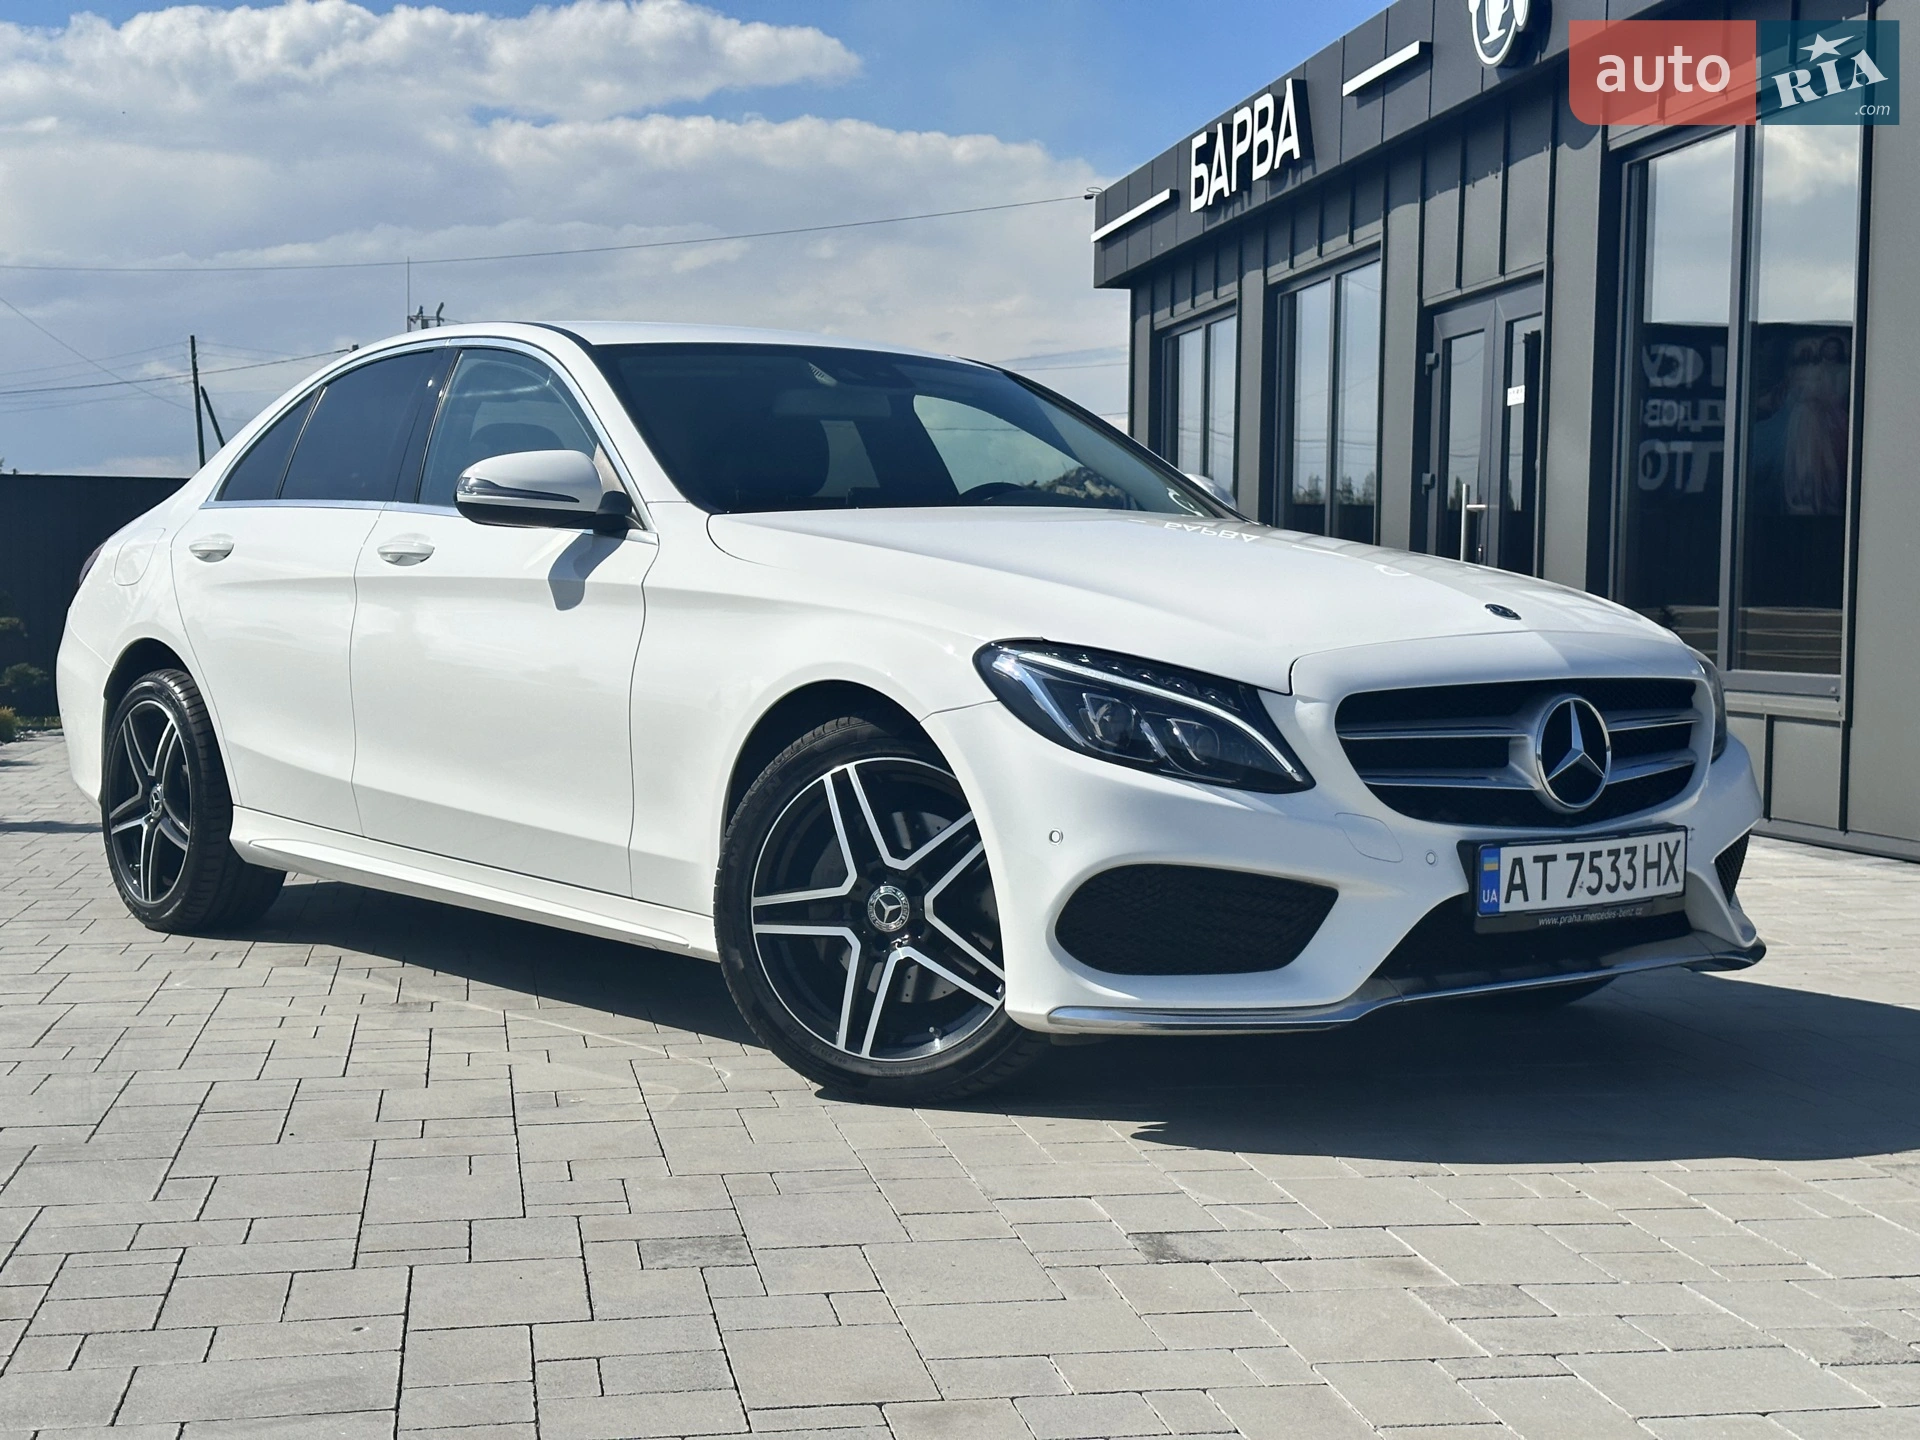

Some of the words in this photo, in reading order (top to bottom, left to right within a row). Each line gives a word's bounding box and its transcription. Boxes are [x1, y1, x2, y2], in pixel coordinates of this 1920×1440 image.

[1190, 78, 1300, 212] БАРВА
[1482, 889, 1498, 904] UA
[1505, 856, 1557, 902] AT
[1566, 846, 1637, 899] 7533
[1643, 840, 1681, 888] HX
